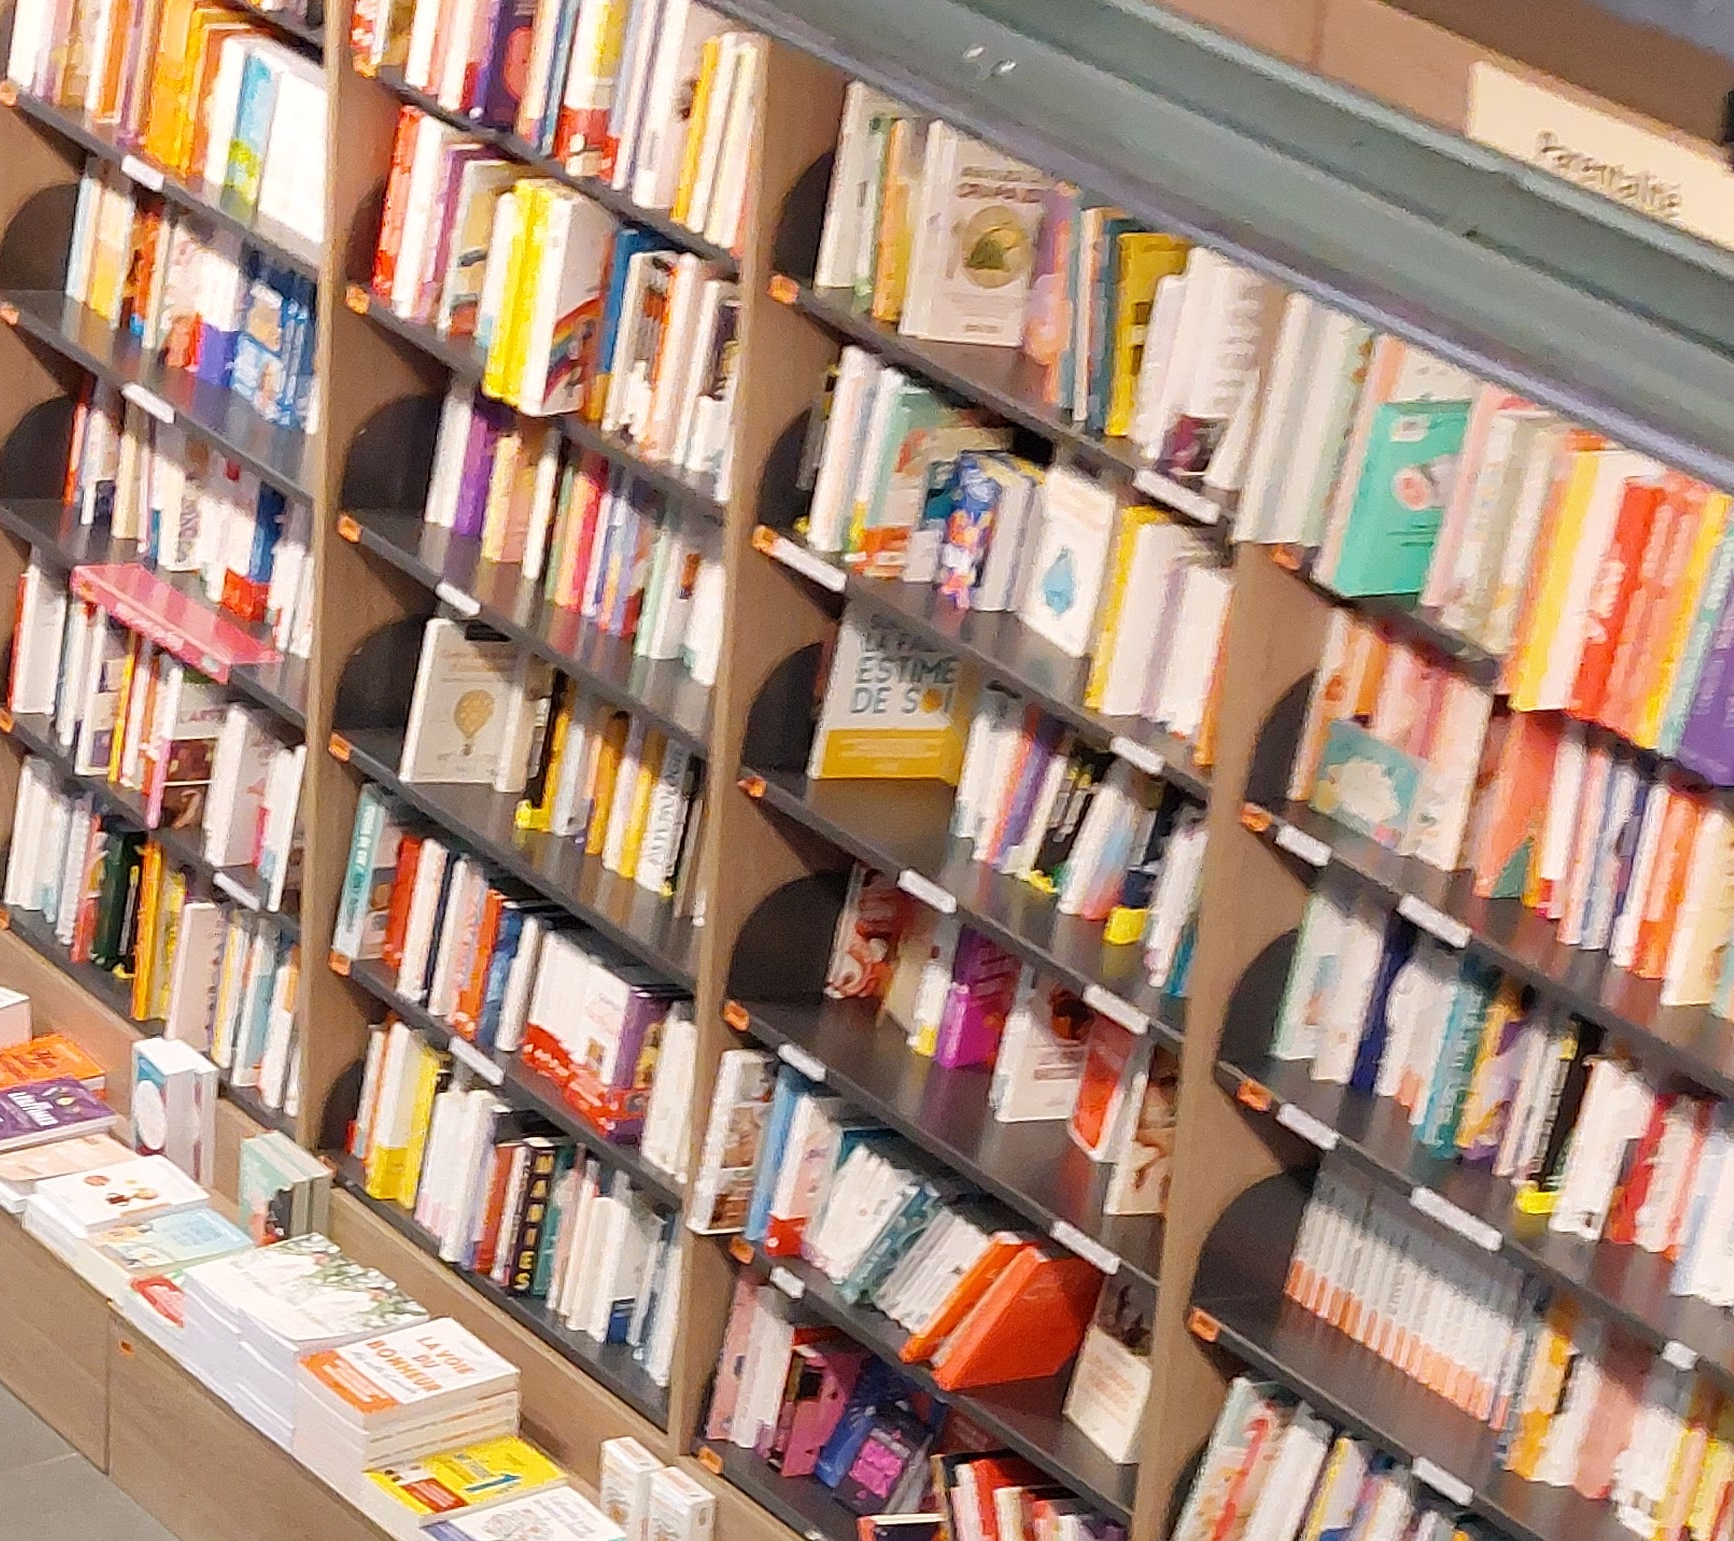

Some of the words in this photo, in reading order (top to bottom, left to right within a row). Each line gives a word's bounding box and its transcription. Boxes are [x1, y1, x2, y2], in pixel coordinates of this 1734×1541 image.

[854, 655, 957, 684] ESTIME
[848, 686, 890, 714] DE
[365, 1338, 443, 1393] BONHEUR
[411, 1354, 440, 1369] DU
[415, 1334, 443, 1352] LA
[435, 1348, 476, 1375] VOIE
